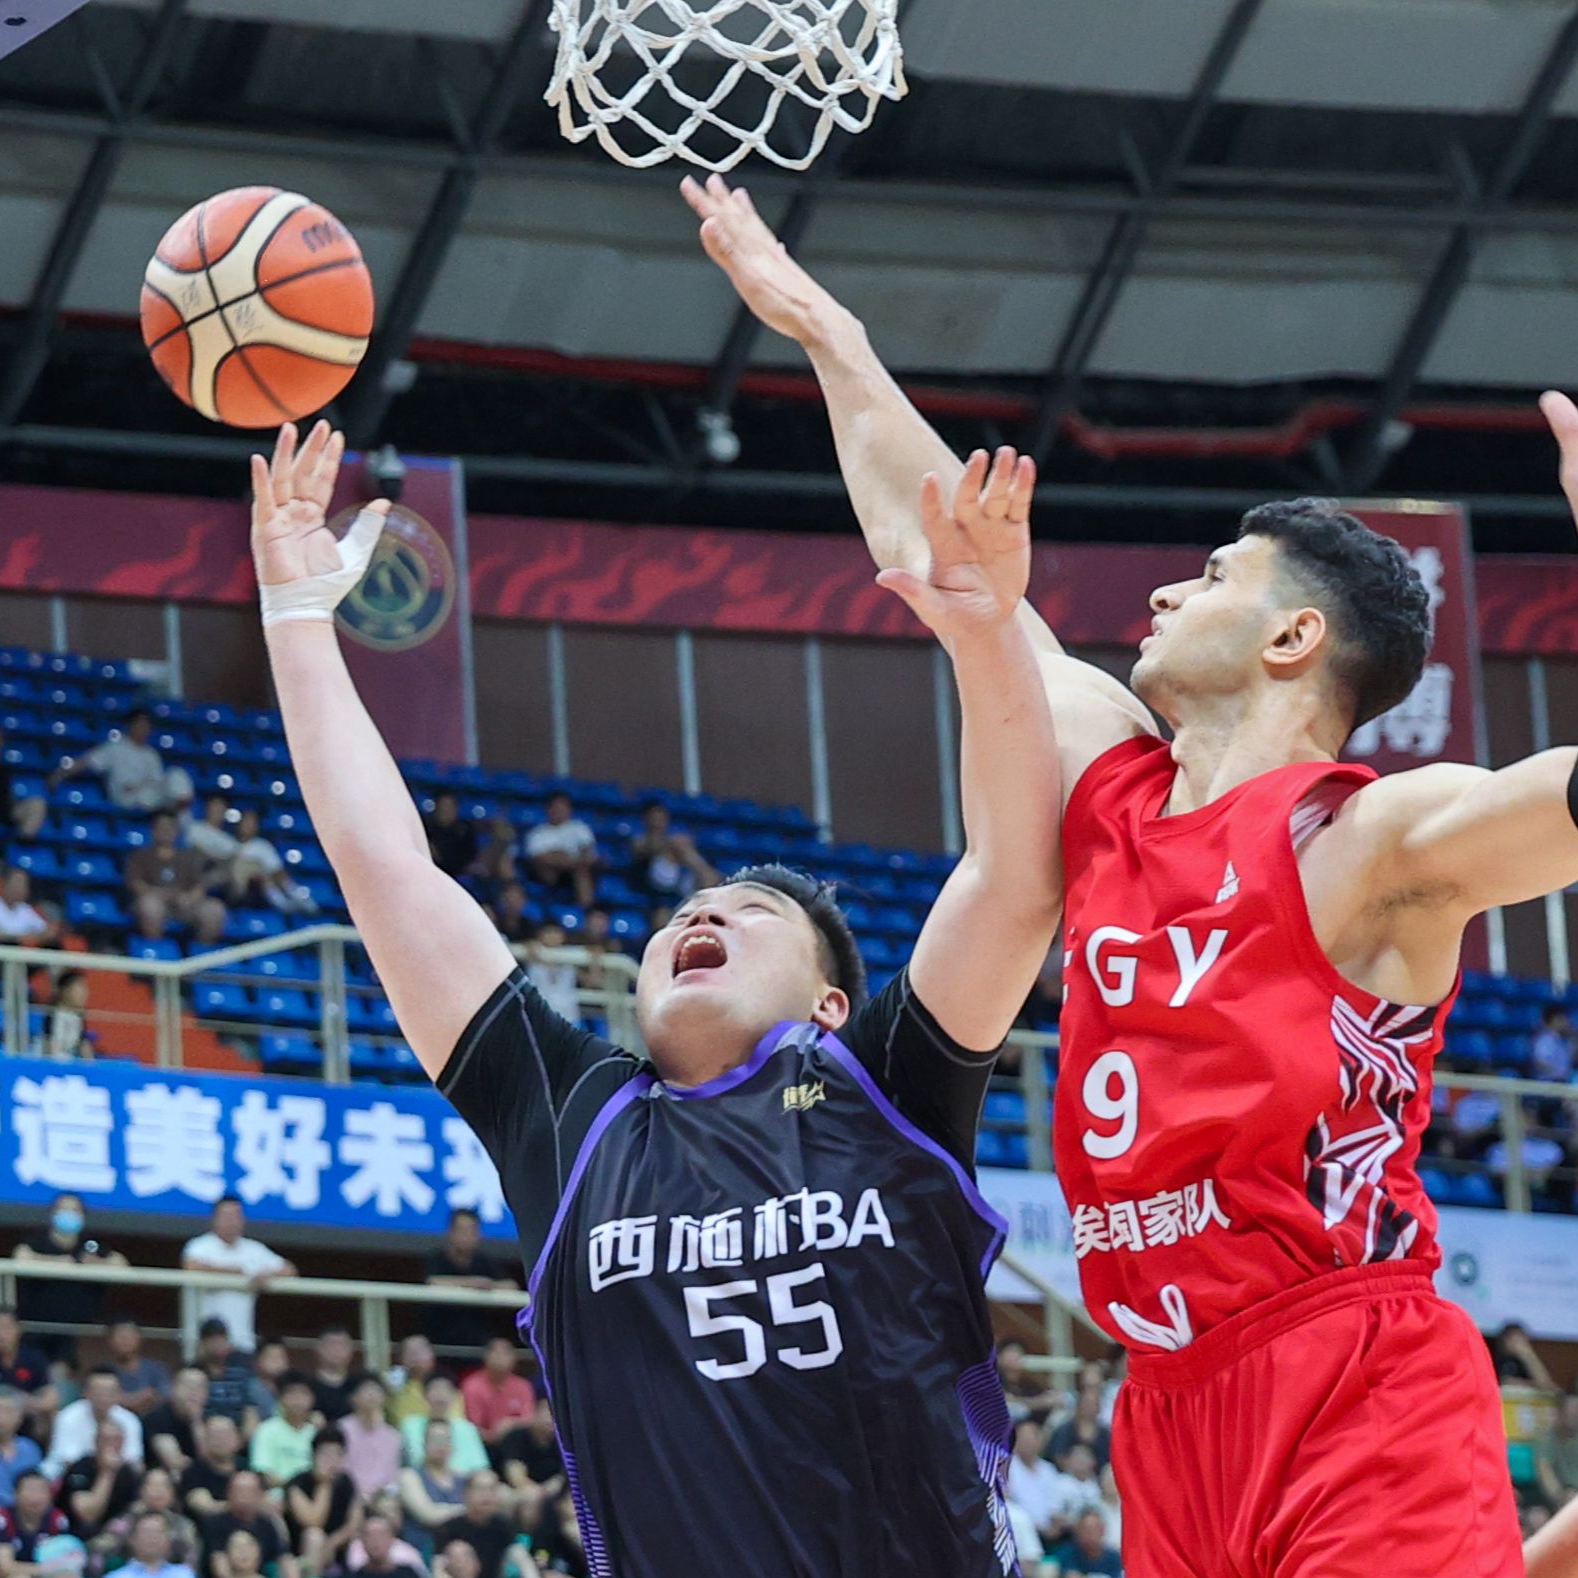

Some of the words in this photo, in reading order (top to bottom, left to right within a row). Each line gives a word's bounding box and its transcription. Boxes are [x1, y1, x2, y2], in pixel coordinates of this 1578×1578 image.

[1062, 924, 1229, 1008] GY
[1082, 1050, 1140, 1160] 9
[684, 1262, 845, 1382] 55
